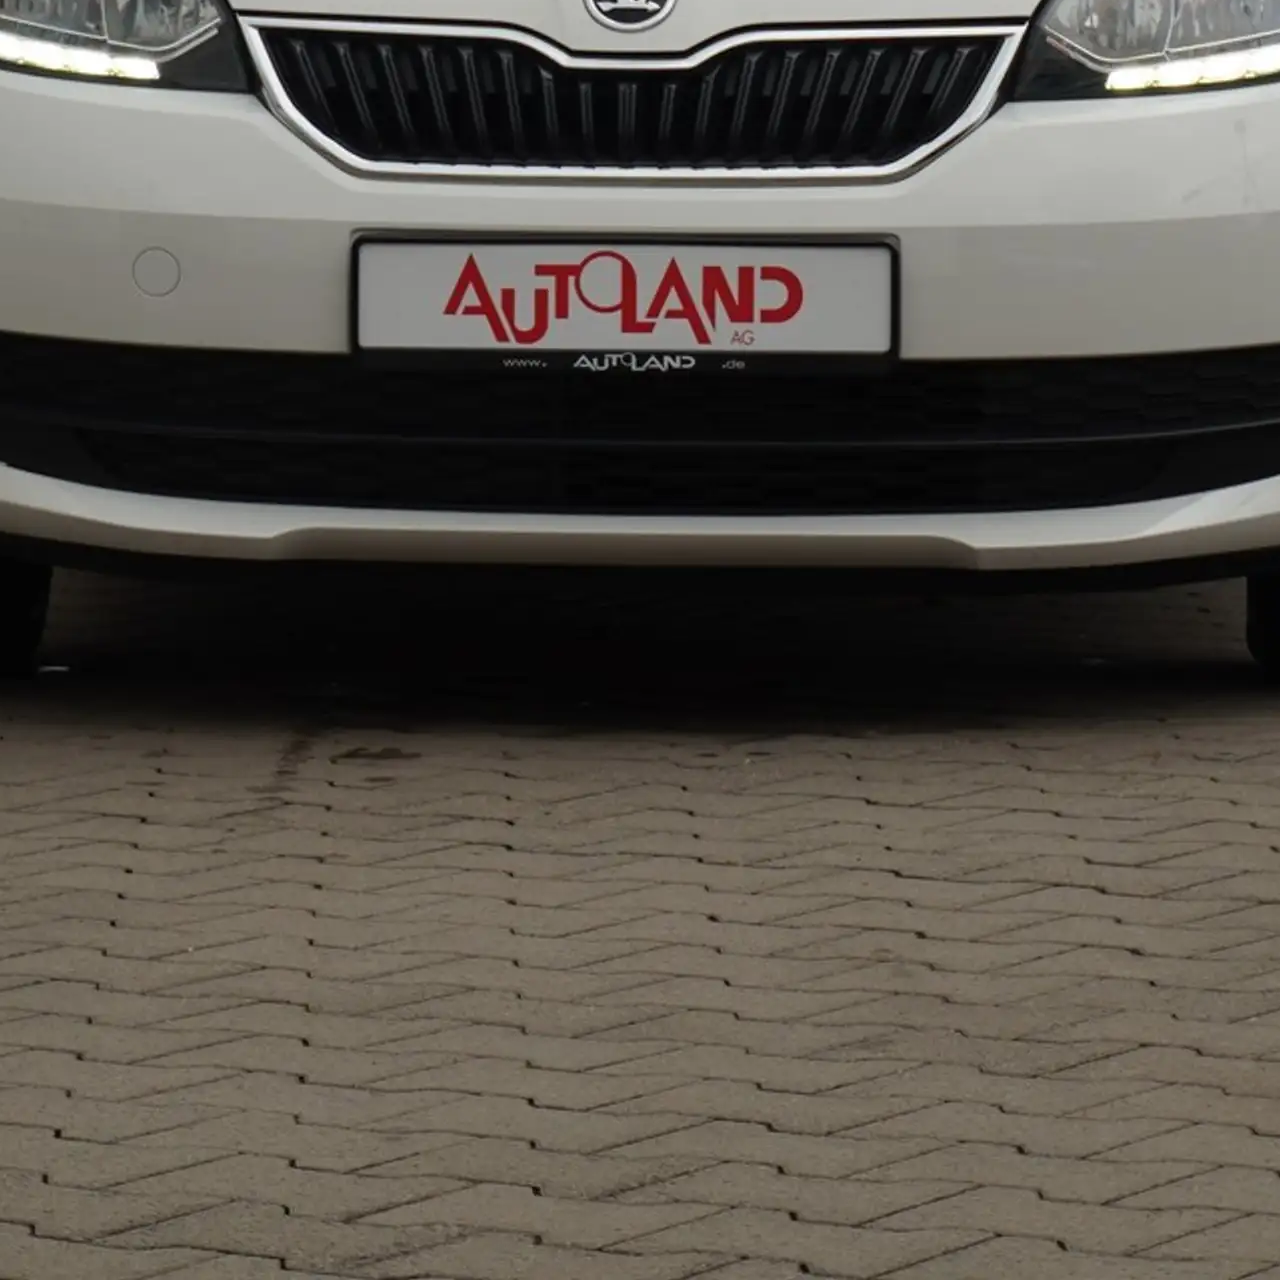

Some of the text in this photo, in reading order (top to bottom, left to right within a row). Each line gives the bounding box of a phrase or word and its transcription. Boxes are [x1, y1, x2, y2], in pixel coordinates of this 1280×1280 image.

[730, 329, 755, 346] AG
[502, 358, 548, 368] www.
[721, 358, 746, 369] .de
